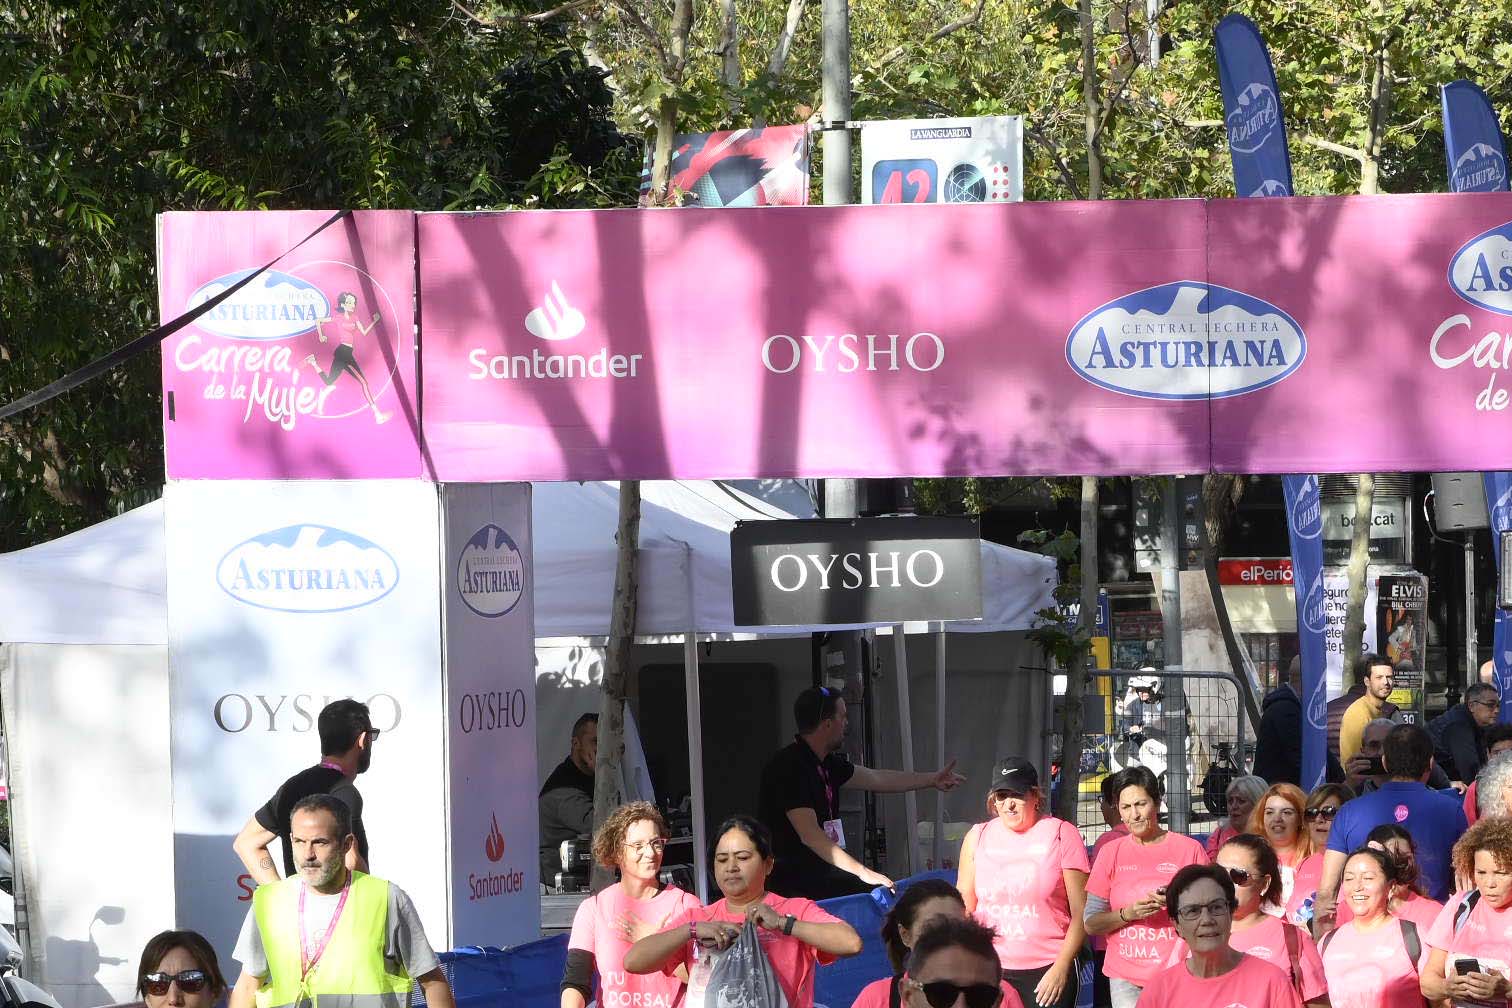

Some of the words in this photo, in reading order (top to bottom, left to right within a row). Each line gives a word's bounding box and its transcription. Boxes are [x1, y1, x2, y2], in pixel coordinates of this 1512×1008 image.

[1121, 323, 1196, 335] CENTRAL
[1204, 321, 1280, 333] LECHERA
[175, 335, 293, 374] Carrera
[468, 347, 643, 381] Santander
[761, 332, 946, 373] OYSHO
[1085, 326, 1288, 370] ASTURIANA
[204, 380, 226, 400] de
[231, 370, 246, 400] la
[244, 364, 337, 431] Mujer
[1475, 373, 1510, 411] de
[230, 558, 386, 591] ASTURIANA
[462, 561, 521, 595] ASTURIANA
[770, 549, 945, 592] OYSHO
[1240, 565, 1294, 581] elPerió
[1391, 585, 1423, 598] ELVIS
[213, 693, 403, 733] OYSO
[460, 688, 526, 734] OYSHO
[1402, 714, 1415, 725] 30
[469, 869, 524, 900] Santander
[999, 922, 1025, 936] MA
[1119, 926, 1174, 941] DORSAL
[1119, 944, 1161, 959] SUMA
[608, 971, 625, 985] TU
[608, 992, 672, 1008] DORSAL
